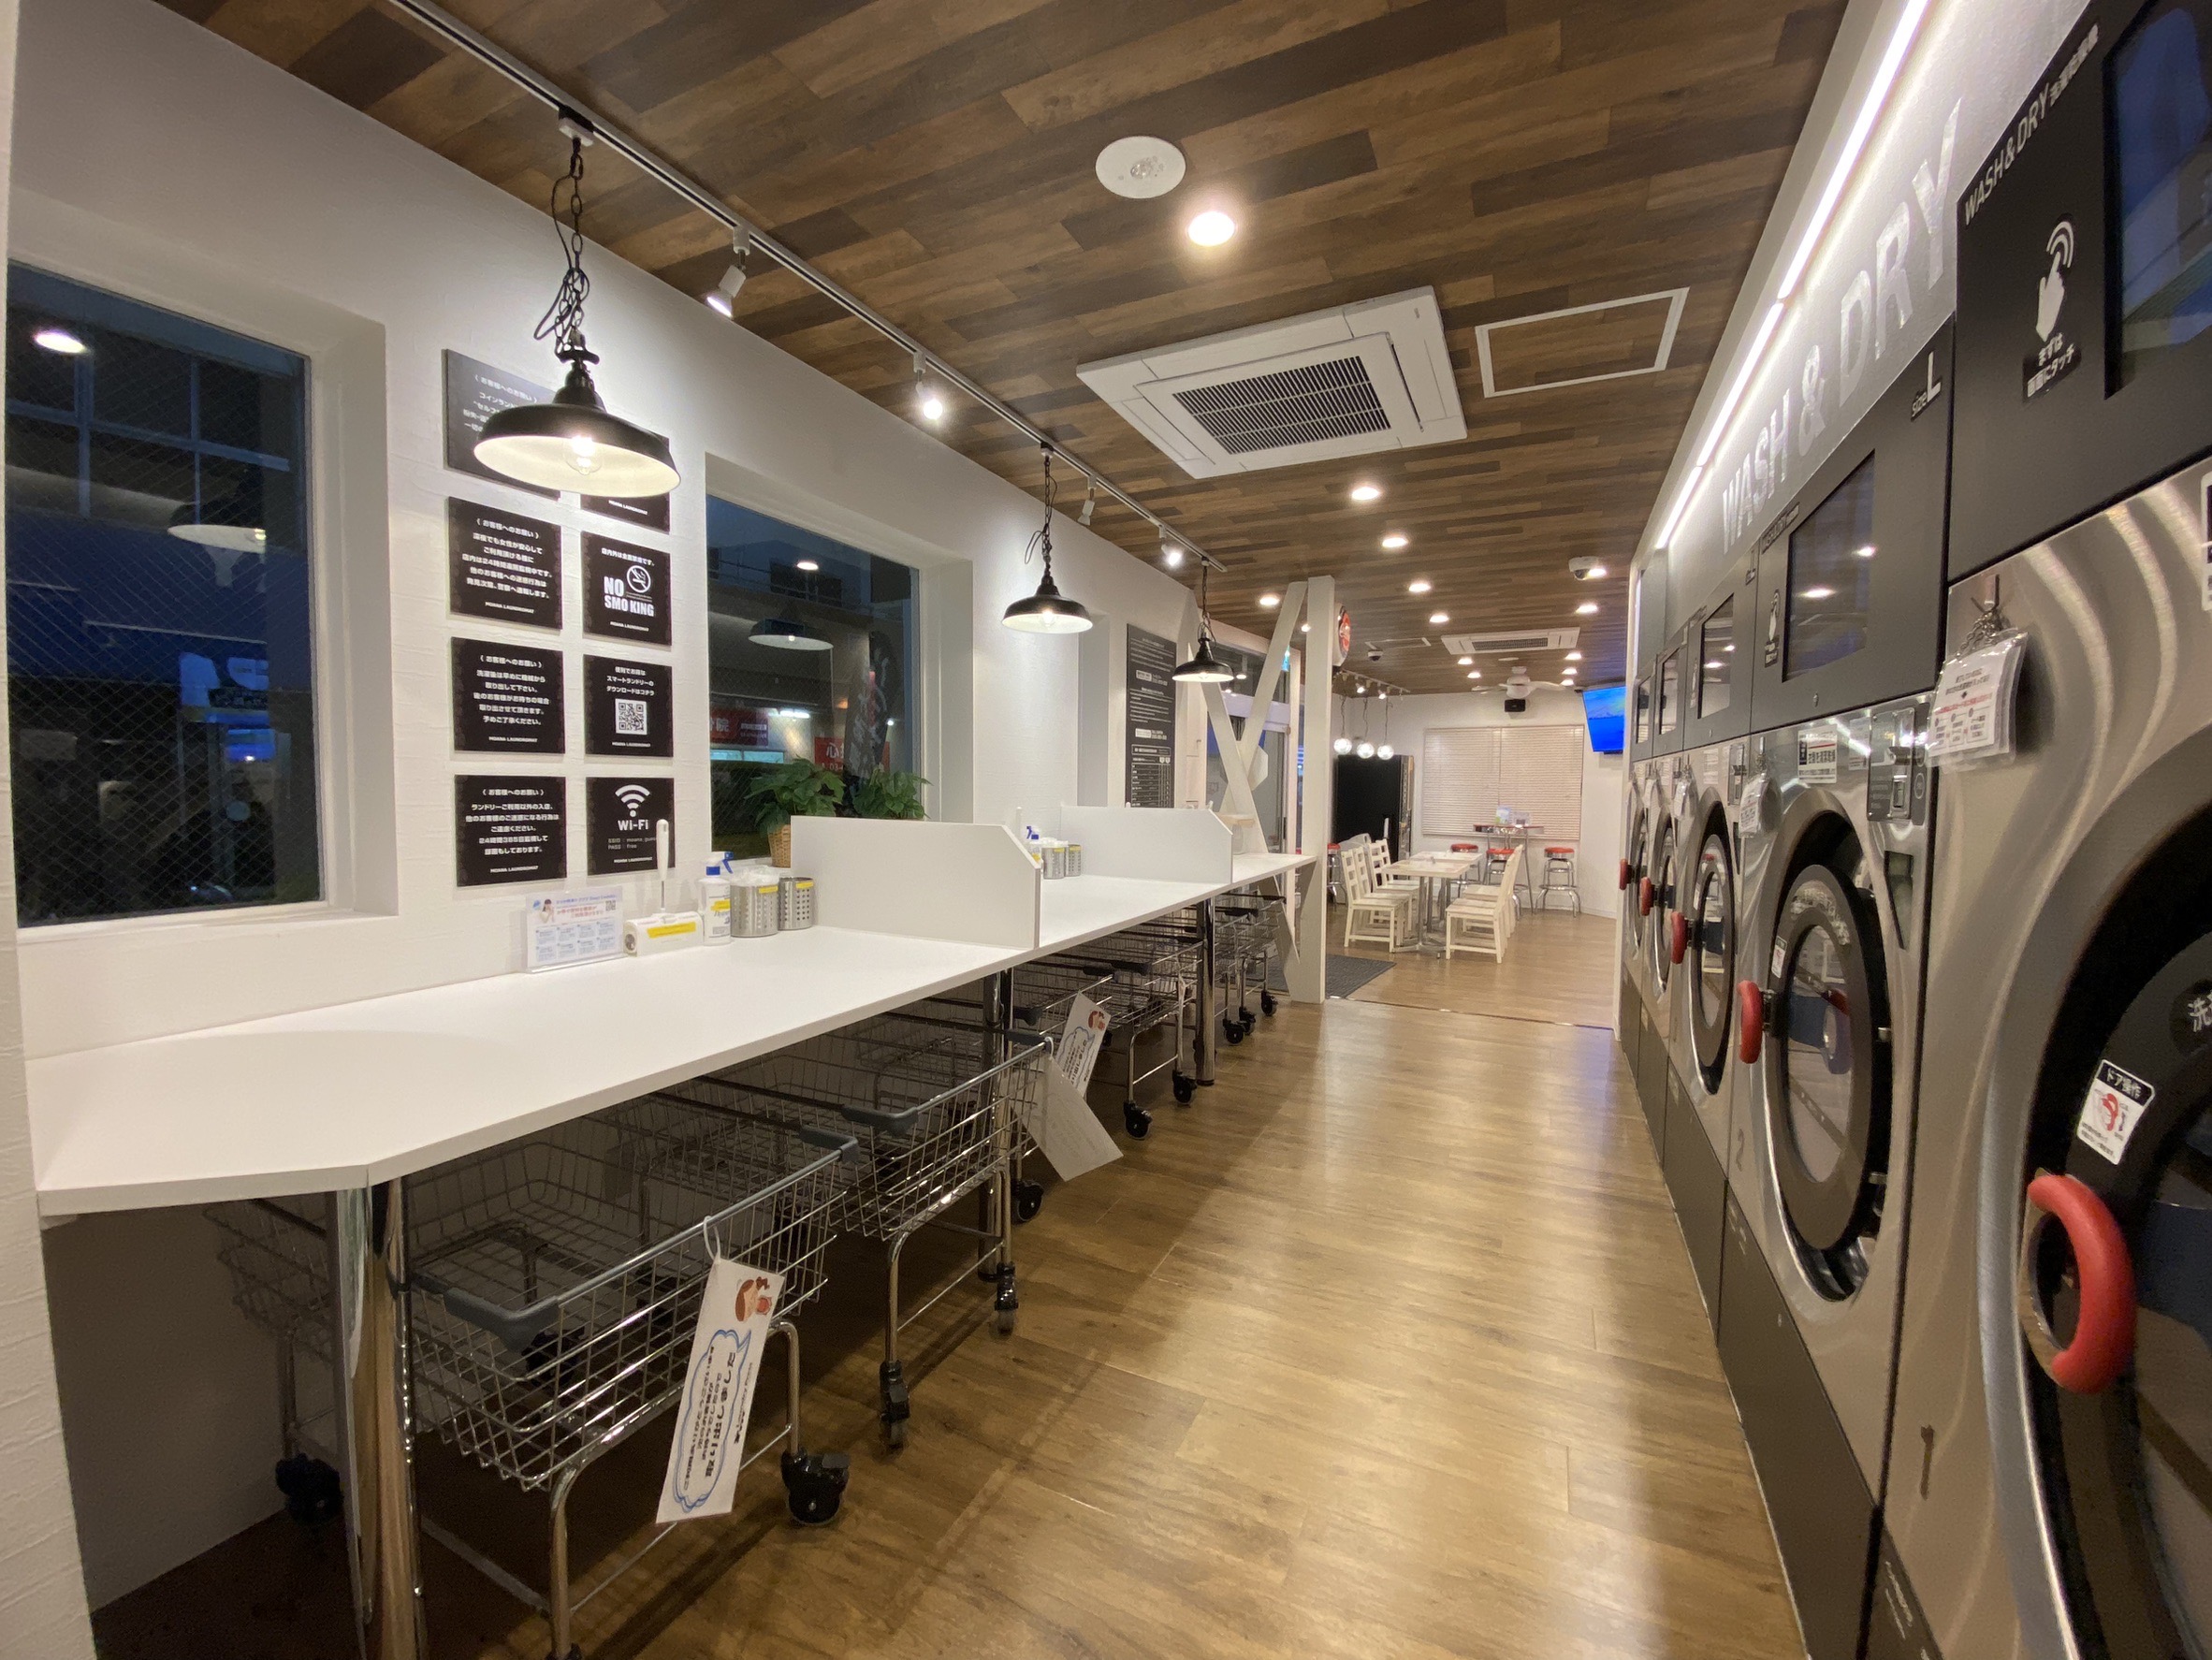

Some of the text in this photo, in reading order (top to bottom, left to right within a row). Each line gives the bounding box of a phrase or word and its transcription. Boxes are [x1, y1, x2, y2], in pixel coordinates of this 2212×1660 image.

[1965, 82, 2049, 226] WASH&DRY
[1723, 387, 1790, 555] WASH
[1798, 343, 1826, 457] &
[1840, 97, 1961, 408] DRY
[1928, 351, 1942, 403] L
[604, 576, 624, 597] NO
[618, 819, 649, 831] Wi-Fi
[705, 1352, 736, 1478] 取り出しました
